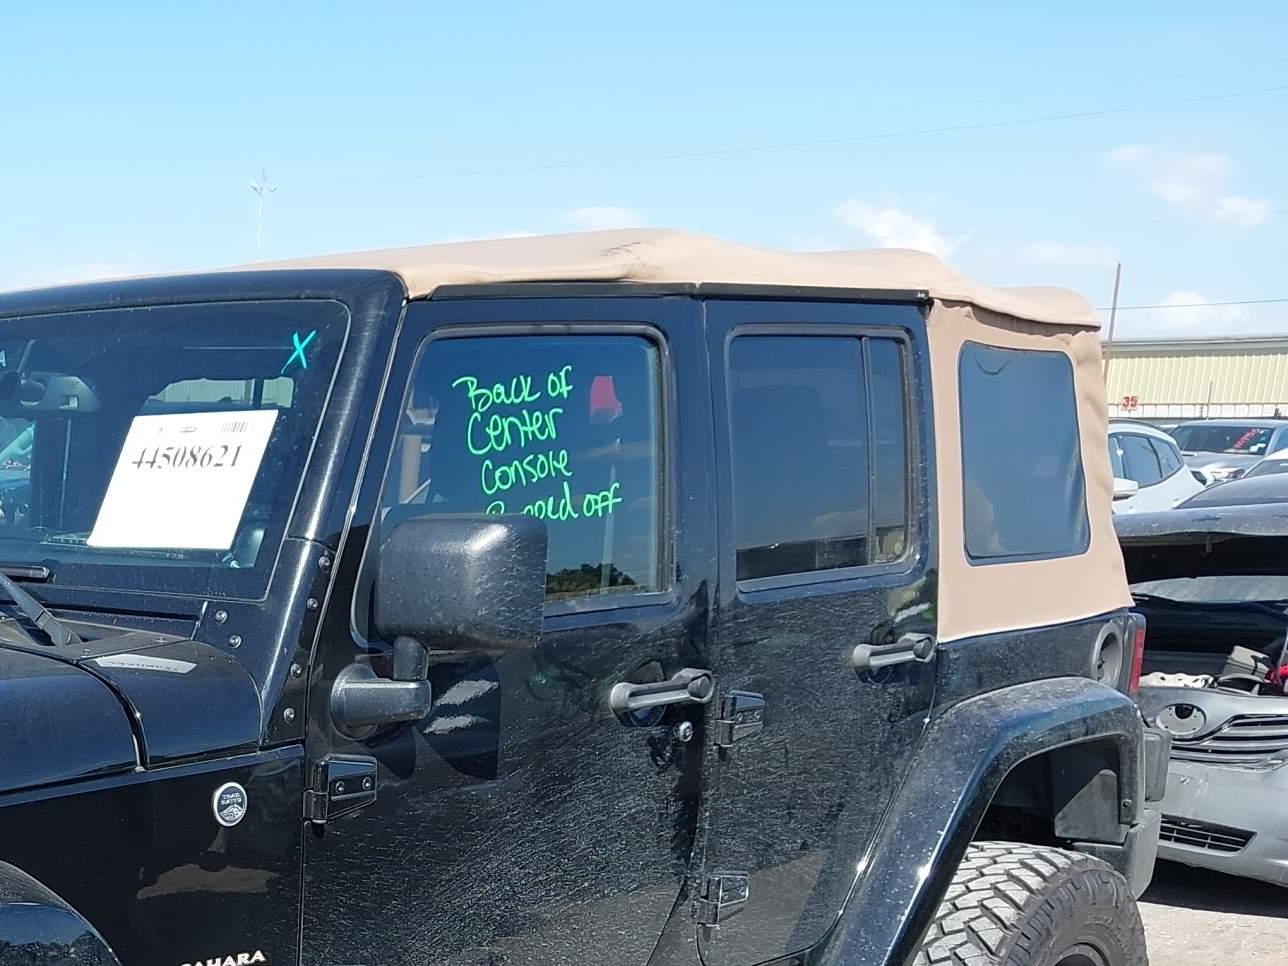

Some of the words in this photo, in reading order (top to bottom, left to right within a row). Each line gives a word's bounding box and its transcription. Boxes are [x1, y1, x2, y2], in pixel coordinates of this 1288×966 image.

[547, 365, 573, 399] of
[132, 444, 243, 469] 44508621
[583, 482, 623, 517] off
